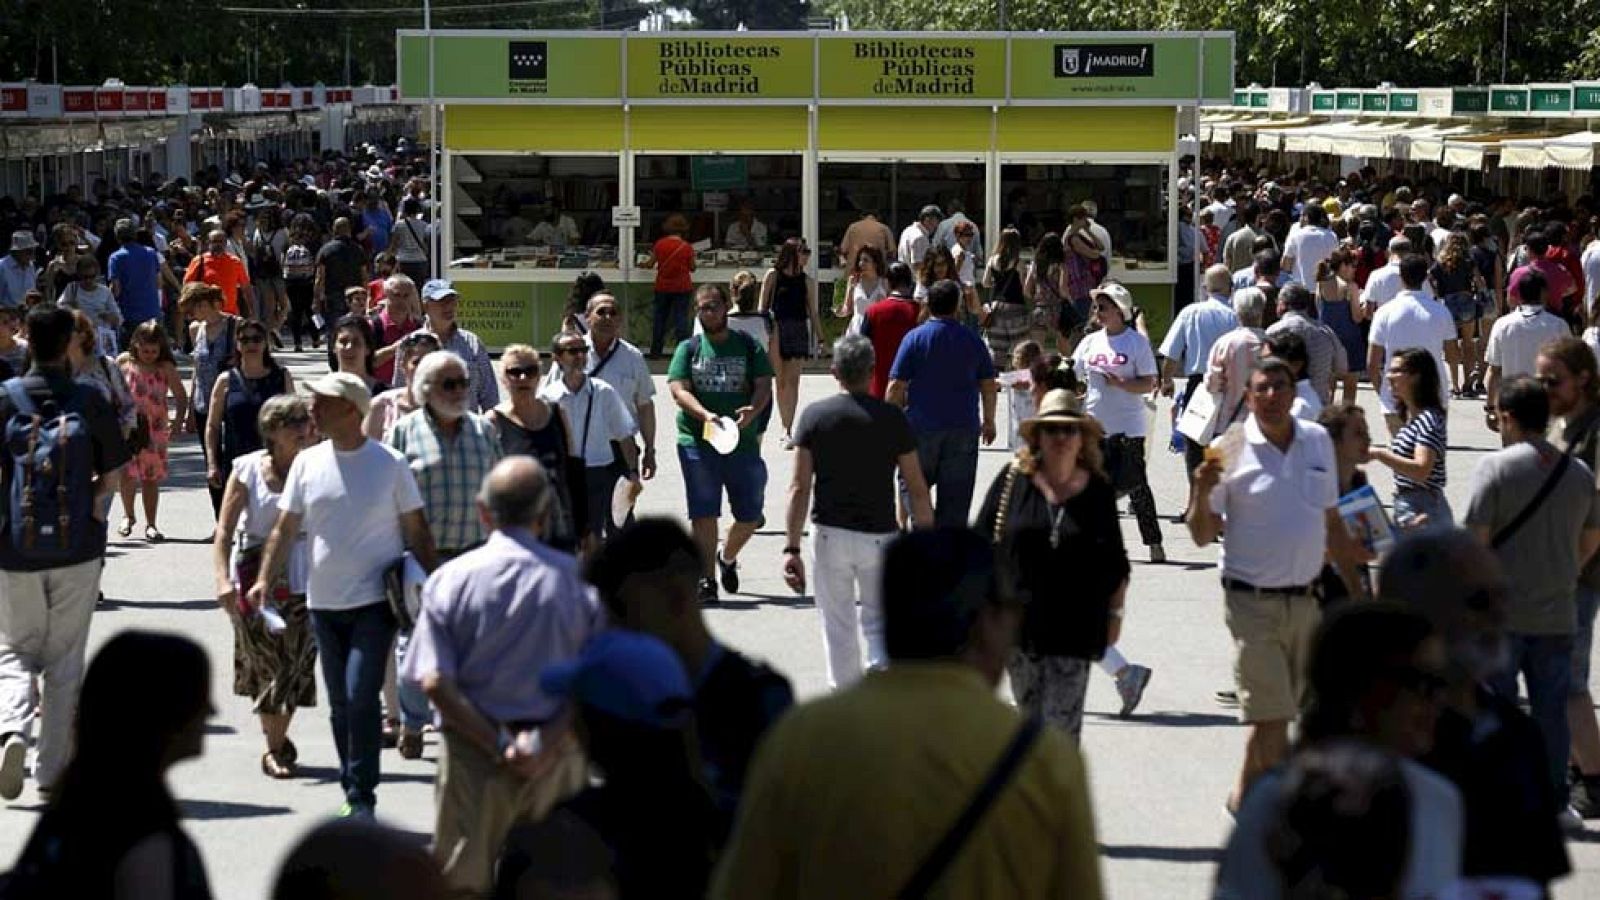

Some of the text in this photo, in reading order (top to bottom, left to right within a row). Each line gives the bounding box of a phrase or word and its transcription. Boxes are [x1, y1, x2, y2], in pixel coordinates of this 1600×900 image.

[659, 41, 781, 58] Bibliotecas
[854, 41, 975, 58] Bibliotecas
[659, 59, 752, 75] Públicas
[882, 59, 975, 75] Públicas
